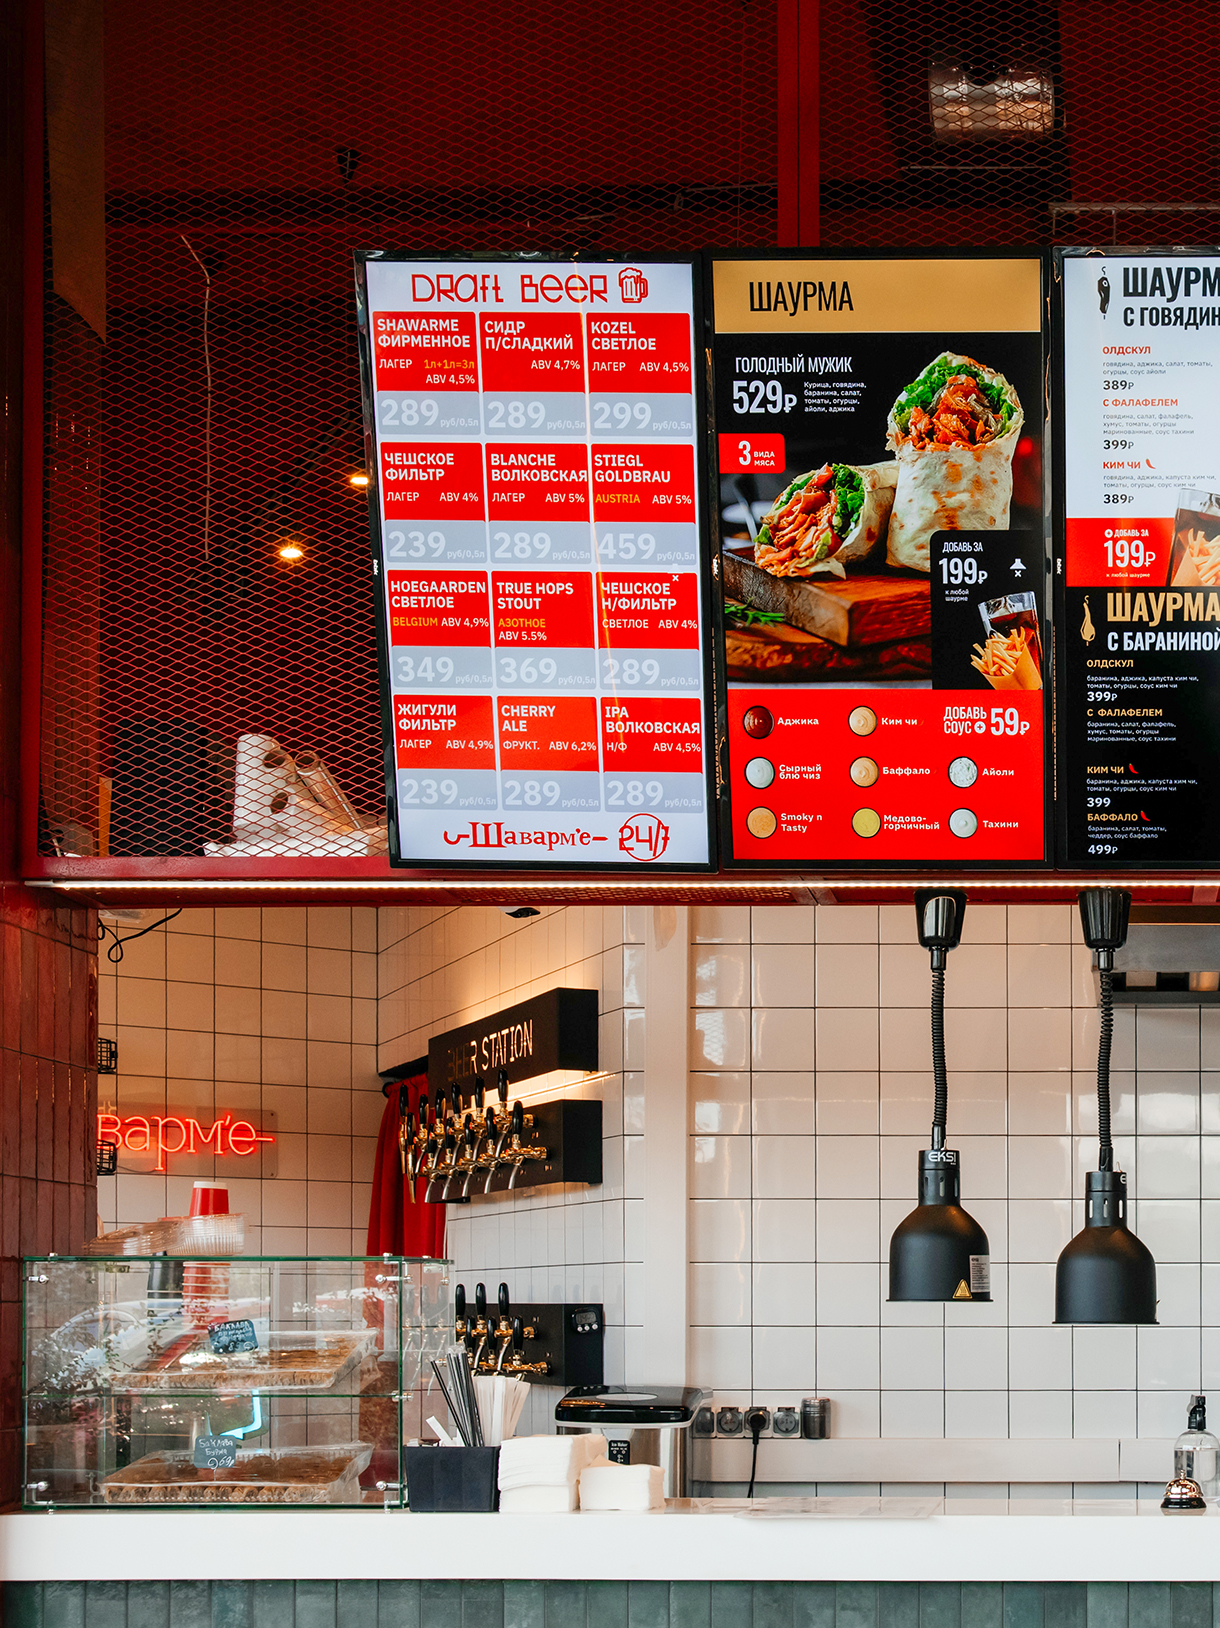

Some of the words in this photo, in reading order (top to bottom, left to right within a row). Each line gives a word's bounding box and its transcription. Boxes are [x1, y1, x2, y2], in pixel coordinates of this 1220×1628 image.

[749, 281, 854, 316] ШАУРМА
[376, 319, 459, 333] SHAWARME
[485, 321, 525, 337] СИДР
[592, 322, 636, 334] KOZEL
[376, 335, 471, 348] ФИРМЕННОЕ
[486, 333, 573, 352] П/СЛАДКИЙ
[592, 338, 656, 350] СВЕТЛОЕ
[1103, 346, 1150, 355] ОЛДСКУЛ
[380, 359, 412, 368] ЛАГЕР
[736, 354, 804, 375] ГОЛОДНЫЙ
[808, 357, 852, 375] МУЖИК
[804, 382, 831, 390] Курица,
[380, 399, 440, 427] 289
[488, 401, 548, 429] 289
[594, 402, 654, 430] 299
[440, 417, 479, 429] руб/0,5л
[385, 453, 454, 464] ЧЕШСКОЕ
[738, 440, 751, 466] 3
[491, 454, 555, 466] BLANCHE
[595, 454, 643, 466] STIEGL
[386, 468, 444, 480] ФИЛЬТР
[491, 469, 588, 482] ВОЛКОВСКАЯ
[595, 470, 670, 482] GOLDBRAU
[595, 494, 640, 504] AUSTRIA
[388, 531, 445, 559] 239
[494, 532, 551, 558] 289
[598, 534, 657, 562] 459
[942, 542, 972, 553] ДОБАВЬ
[973, 542, 983, 552] ЗА
[391, 581, 485, 593] HOEGAARDEN
[497, 582, 532, 594] TRUE
[536, 583, 573, 594] HOPS
[602, 582, 671, 596] ЧЕШСКОЕ
[392, 596, 454, 608] СВЕТЛОЕ
[498, 598, 541, 609] STOUT
[602, 597, 677, 611] Н/ФИЛЬТР
[499, 618, 545, 627] АЗОТНОЕ
[398, 656, 454, 682] 349
[500, 658, 559, 683] 369
[603, 658, 660, 686] 289
[398, 703, 457, 716] ЖИГУЛИ
[502, 705, 555, 717] CHERRY
[606, 706, 629, 718] IPA
[944, 707, 986, 721] ДОБАВЬ
[399, 718, 456, 730] ФИЛЬТР
[502, 720, 527, 731] ALE
[778, 718, 818, 726] Аджика
[881, 717, 900, 726] Ким
[904, 718, 918, 726] чи
[606, 721, 702, 735] ВОЛКОВСКАЯ
[944, 721, 972, 735] СОУС
[503, 740, 539, 750] ФРУКТ.
[779, 764, 822, 774] Сырный
[883, 767, 930, 776] Баффало
[779, 772, 800, 780] блю
[400, 779, 458, 807] 239
[504, 780, 560, 805] 289
[607, 780, 666, 807] 289
[1087, 798, 1110, 807] 399
[781, 812, 813, 823] Smoky
[884, 814, 926, 823] Медово-
[781, 824, 807, 833] Tasty
[884, 822, 940, 831] горчичный
[482, 1019, 533, 1071] STATION
